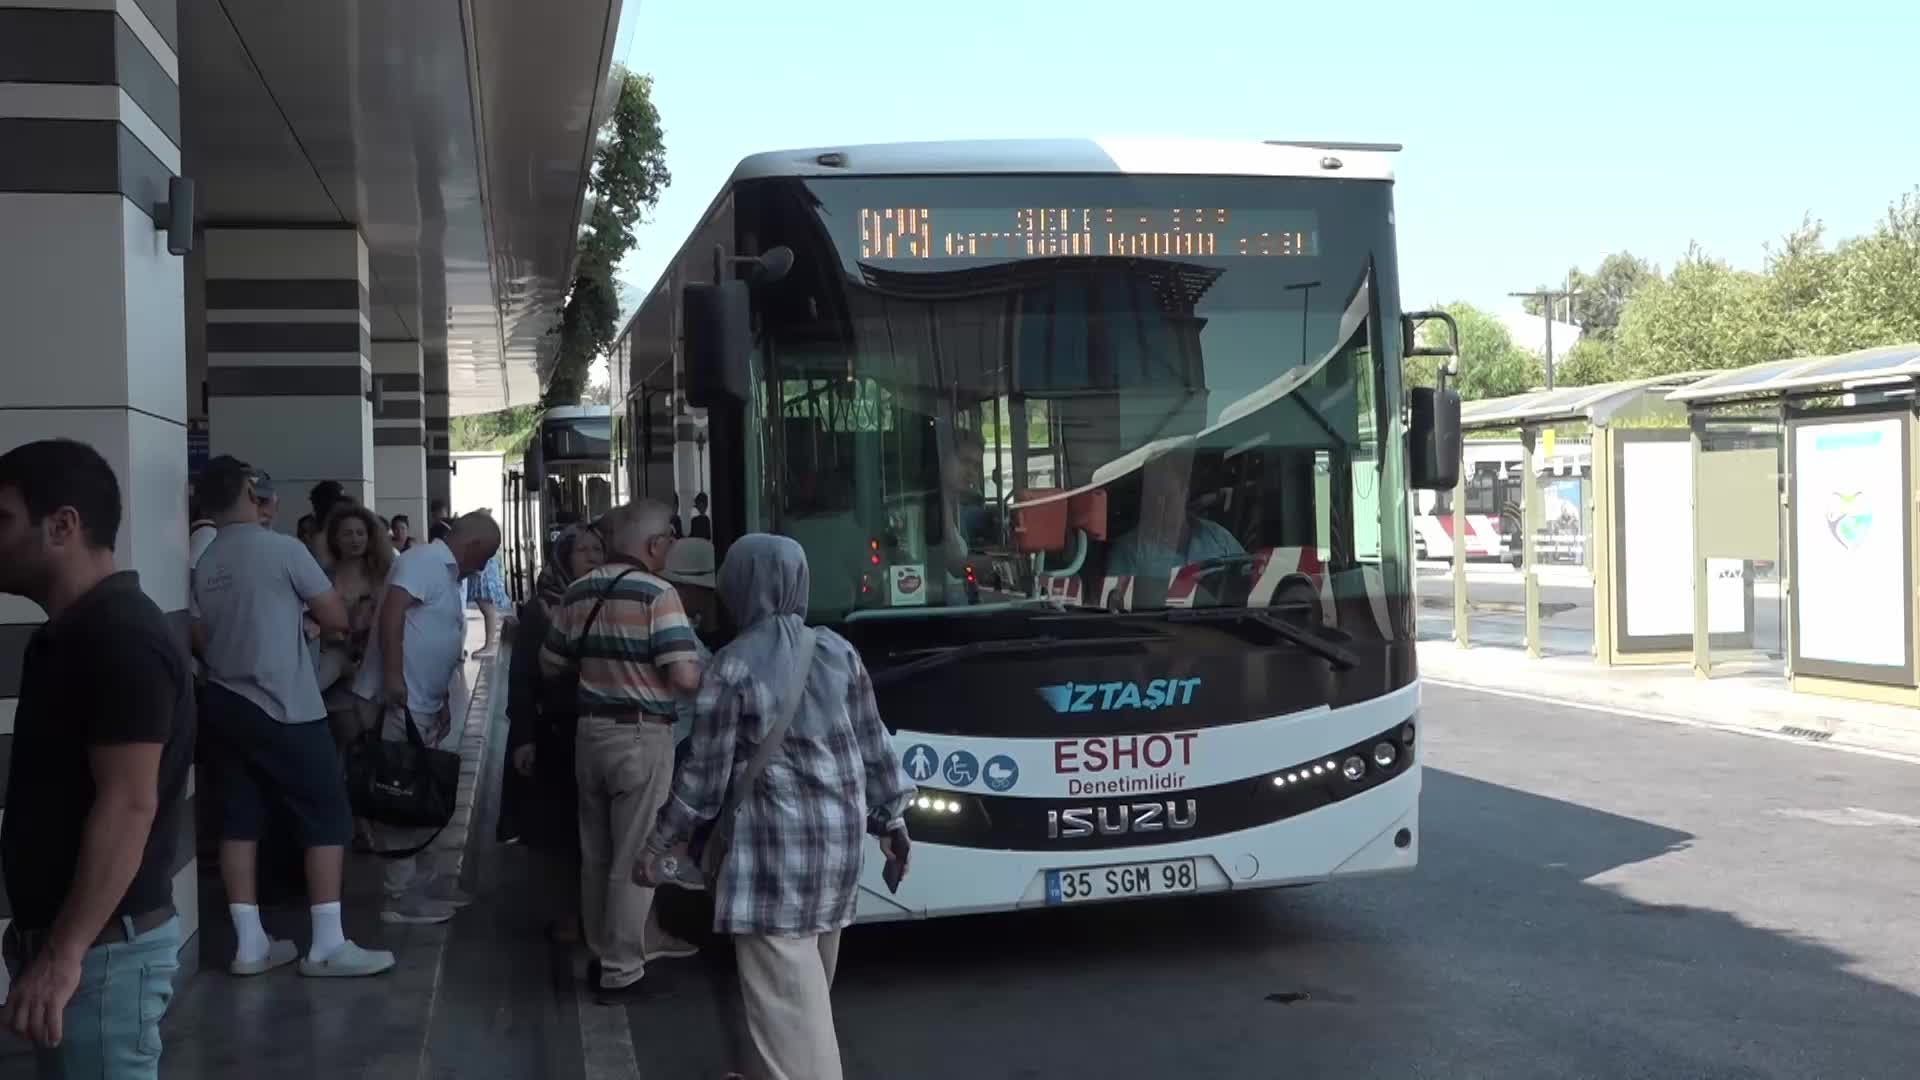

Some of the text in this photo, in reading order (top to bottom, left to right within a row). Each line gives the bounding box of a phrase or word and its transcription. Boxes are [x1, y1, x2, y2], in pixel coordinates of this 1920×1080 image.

[1054, 733, 1198, 774] ESHOT
[1069, 773, 1186, 796] Denetimlidir
[1047, 799, 1196, 839] ISUZU
[1062, 863, 1193, 898] 35 SGM 98
